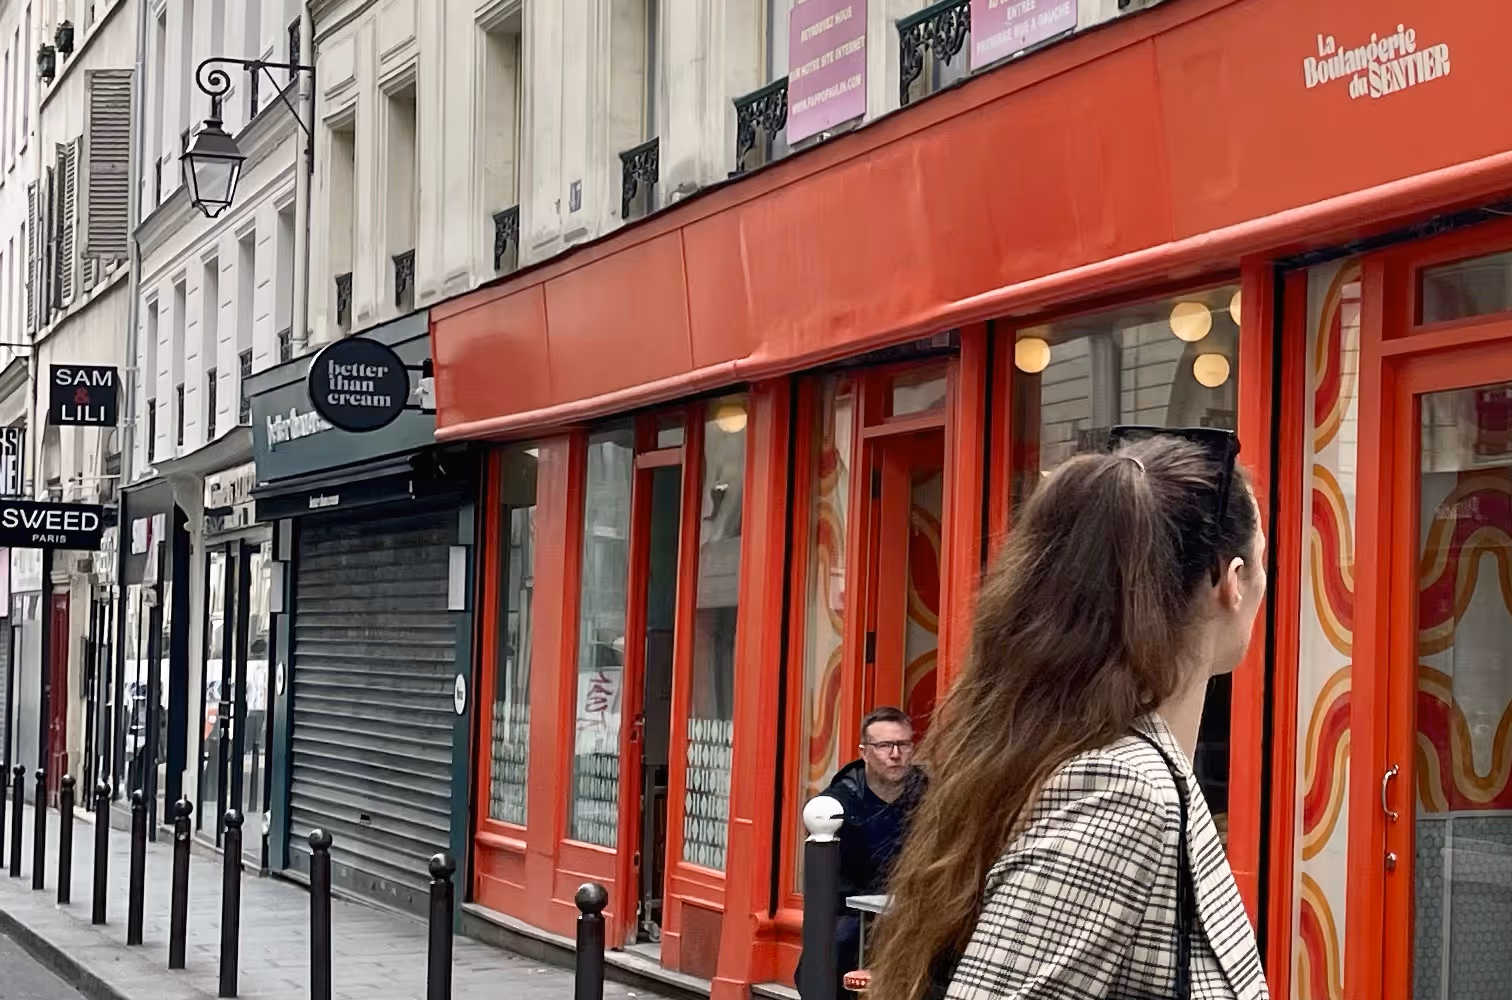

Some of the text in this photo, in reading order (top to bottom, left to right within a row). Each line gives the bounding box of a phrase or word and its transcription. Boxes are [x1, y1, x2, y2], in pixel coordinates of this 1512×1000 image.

[1317, 33, 1335, 57] La
[1303, 24, 1417, 88] Boulangerie
[1349, 43, 1450, 99] du SENTIER
[55, 368, 112, 387] SAM
[328, 359, 389, 378] better
[328, 374, 375, 392] than
[74, 387, 90, 403] &
[327, 392, 392, 407] cream
[61, 404, 105, 422] LILI
[2, 508, 99, 531] SWEED
[32, 534, 67, 544] PARIS
